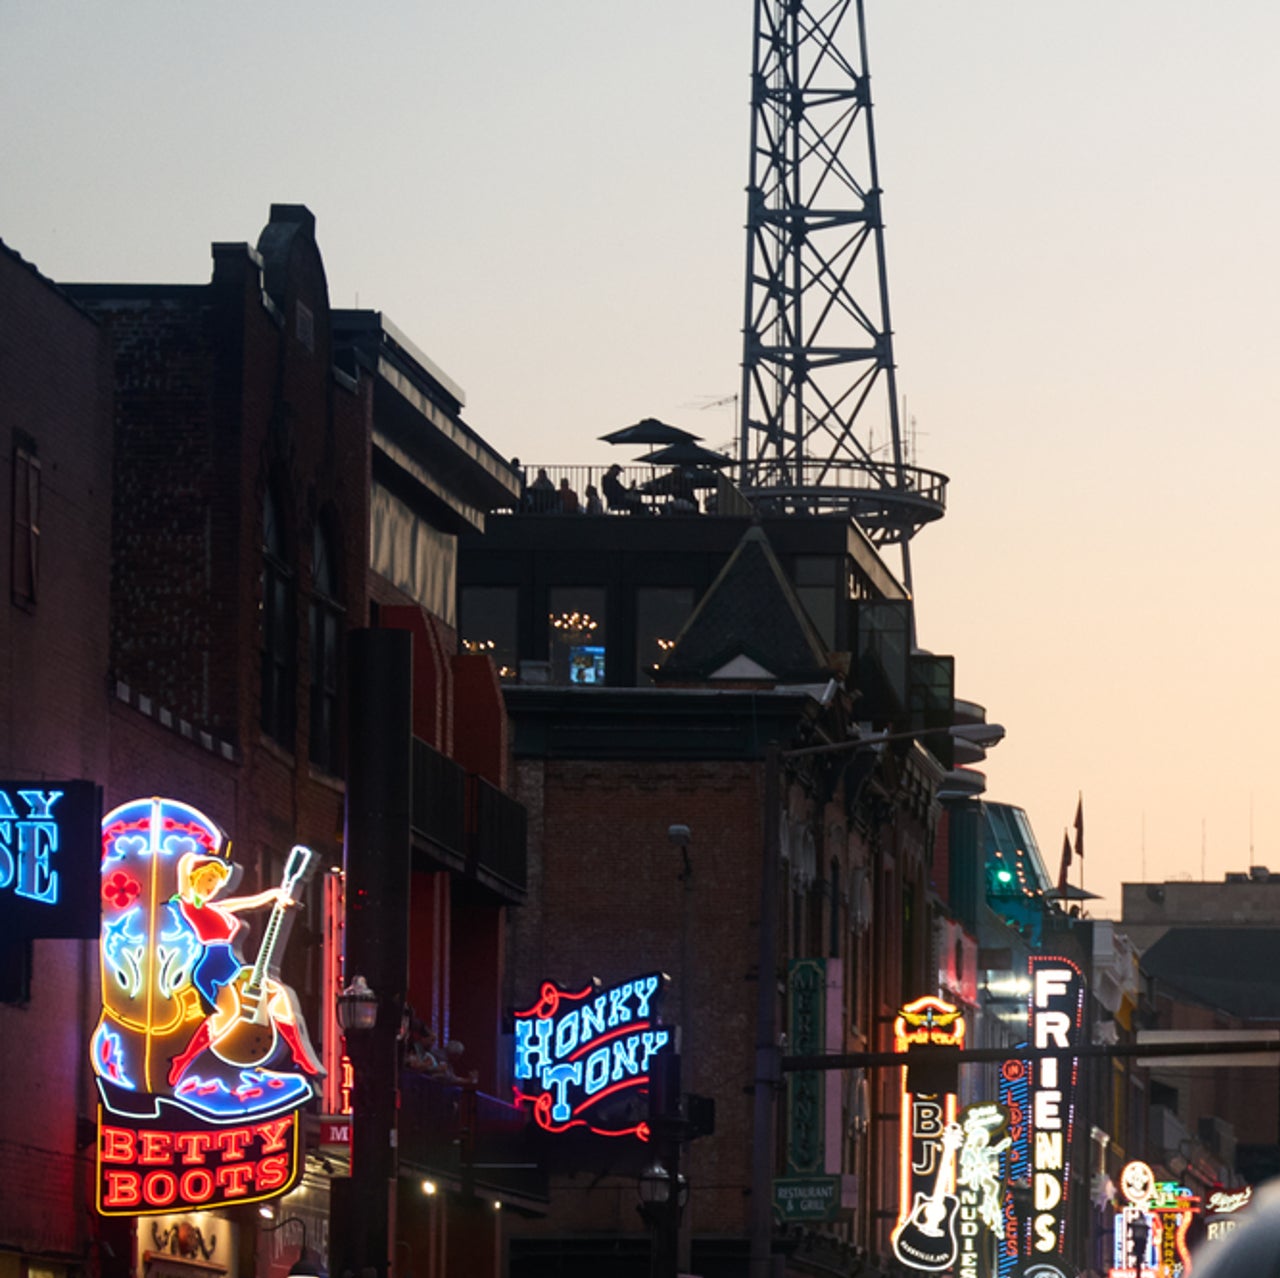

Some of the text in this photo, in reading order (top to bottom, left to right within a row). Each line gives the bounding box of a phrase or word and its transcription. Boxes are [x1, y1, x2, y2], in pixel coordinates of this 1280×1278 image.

[514, 974, 659, 1080] HONKY
[793, 972, 816, 1166] MERCANTS
[1034, 968, 1073, 1253] FRIENDS
[101, 1114, 294, 1166] BETTY
[912, 1093, 944, 1176] BJ
[103, 1152, 289, 1208] BOOTS
[777, 1186, 834, 1199] RESTAURANT
